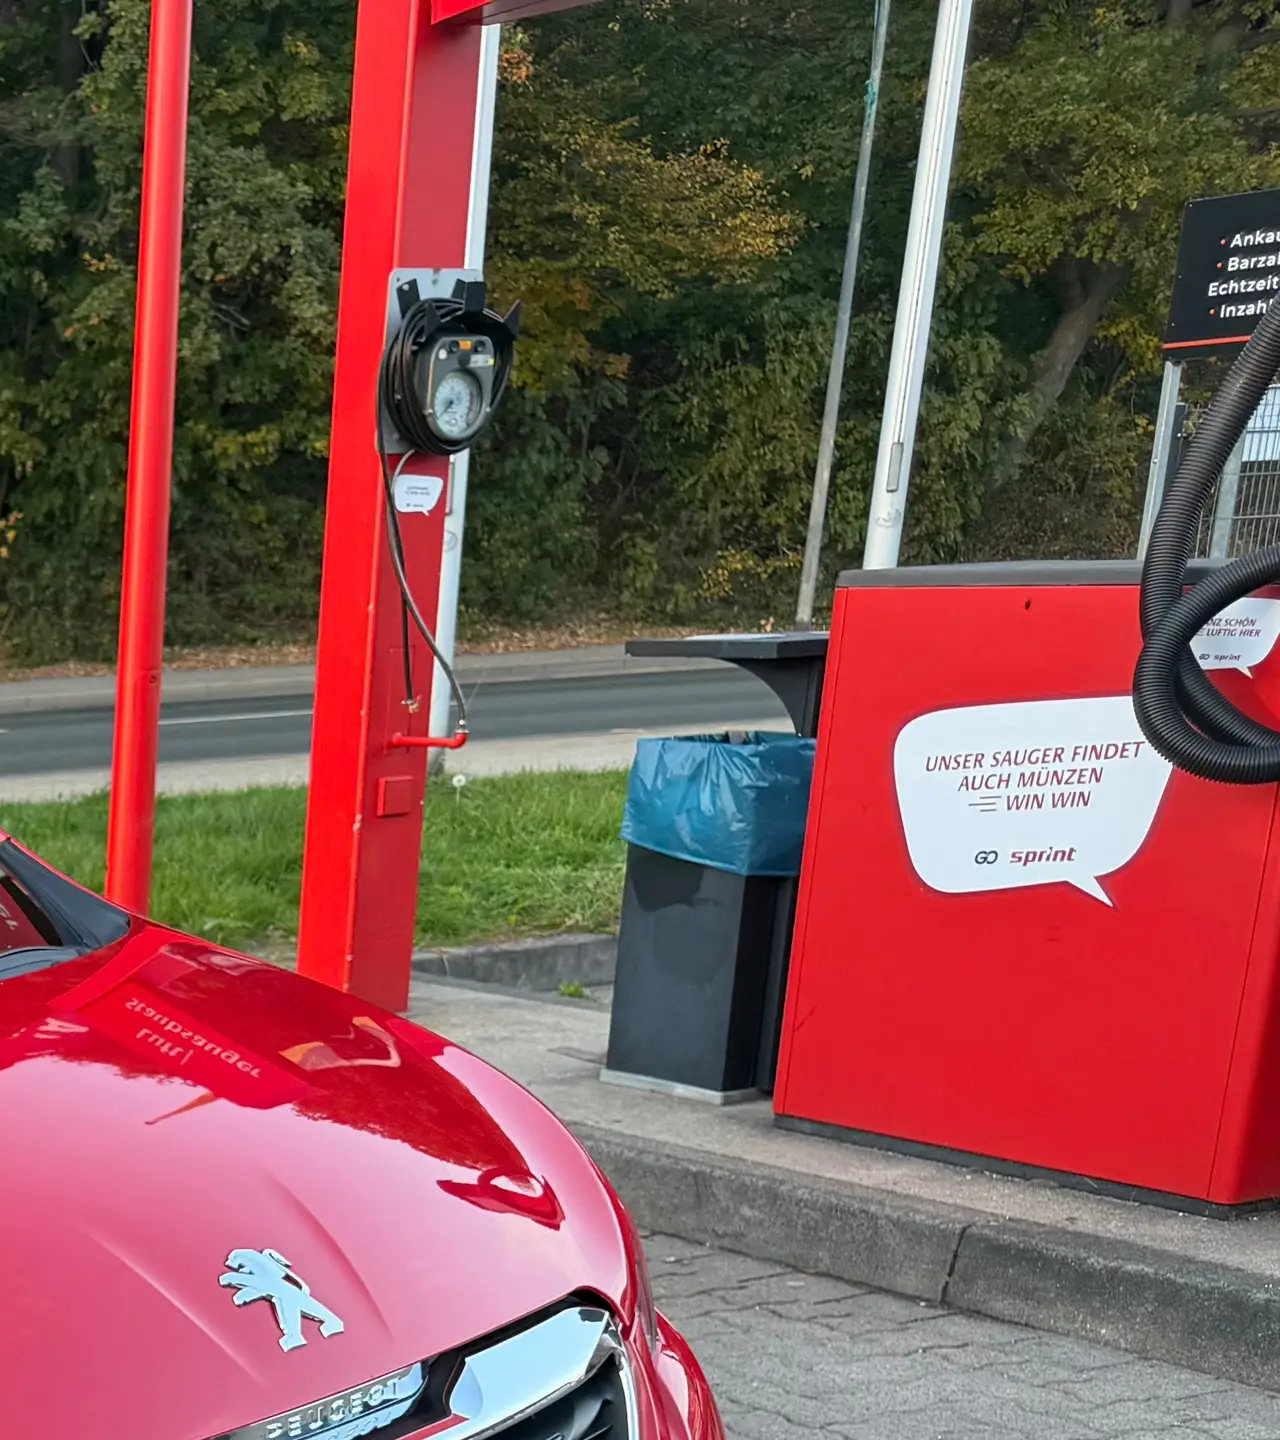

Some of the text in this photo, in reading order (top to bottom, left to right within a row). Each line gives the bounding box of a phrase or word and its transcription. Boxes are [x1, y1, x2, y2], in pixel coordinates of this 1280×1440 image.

[1227, 252, 1280, 272] Barza
[1224, 616, 1258, 627] SCHÖN
[1206, 628, 1262, 638] LUFTIG HIER
[1213, 653, 1242, 662] sprint
[925, 740, 1146, 772] UNSER SAUGER FINDET
[957, 765, 1104, 792] AUCH MÜNZEN
[1006, 790, 1091, 811] WIN WIN
[1009, 846, 1077, 867] sprint
